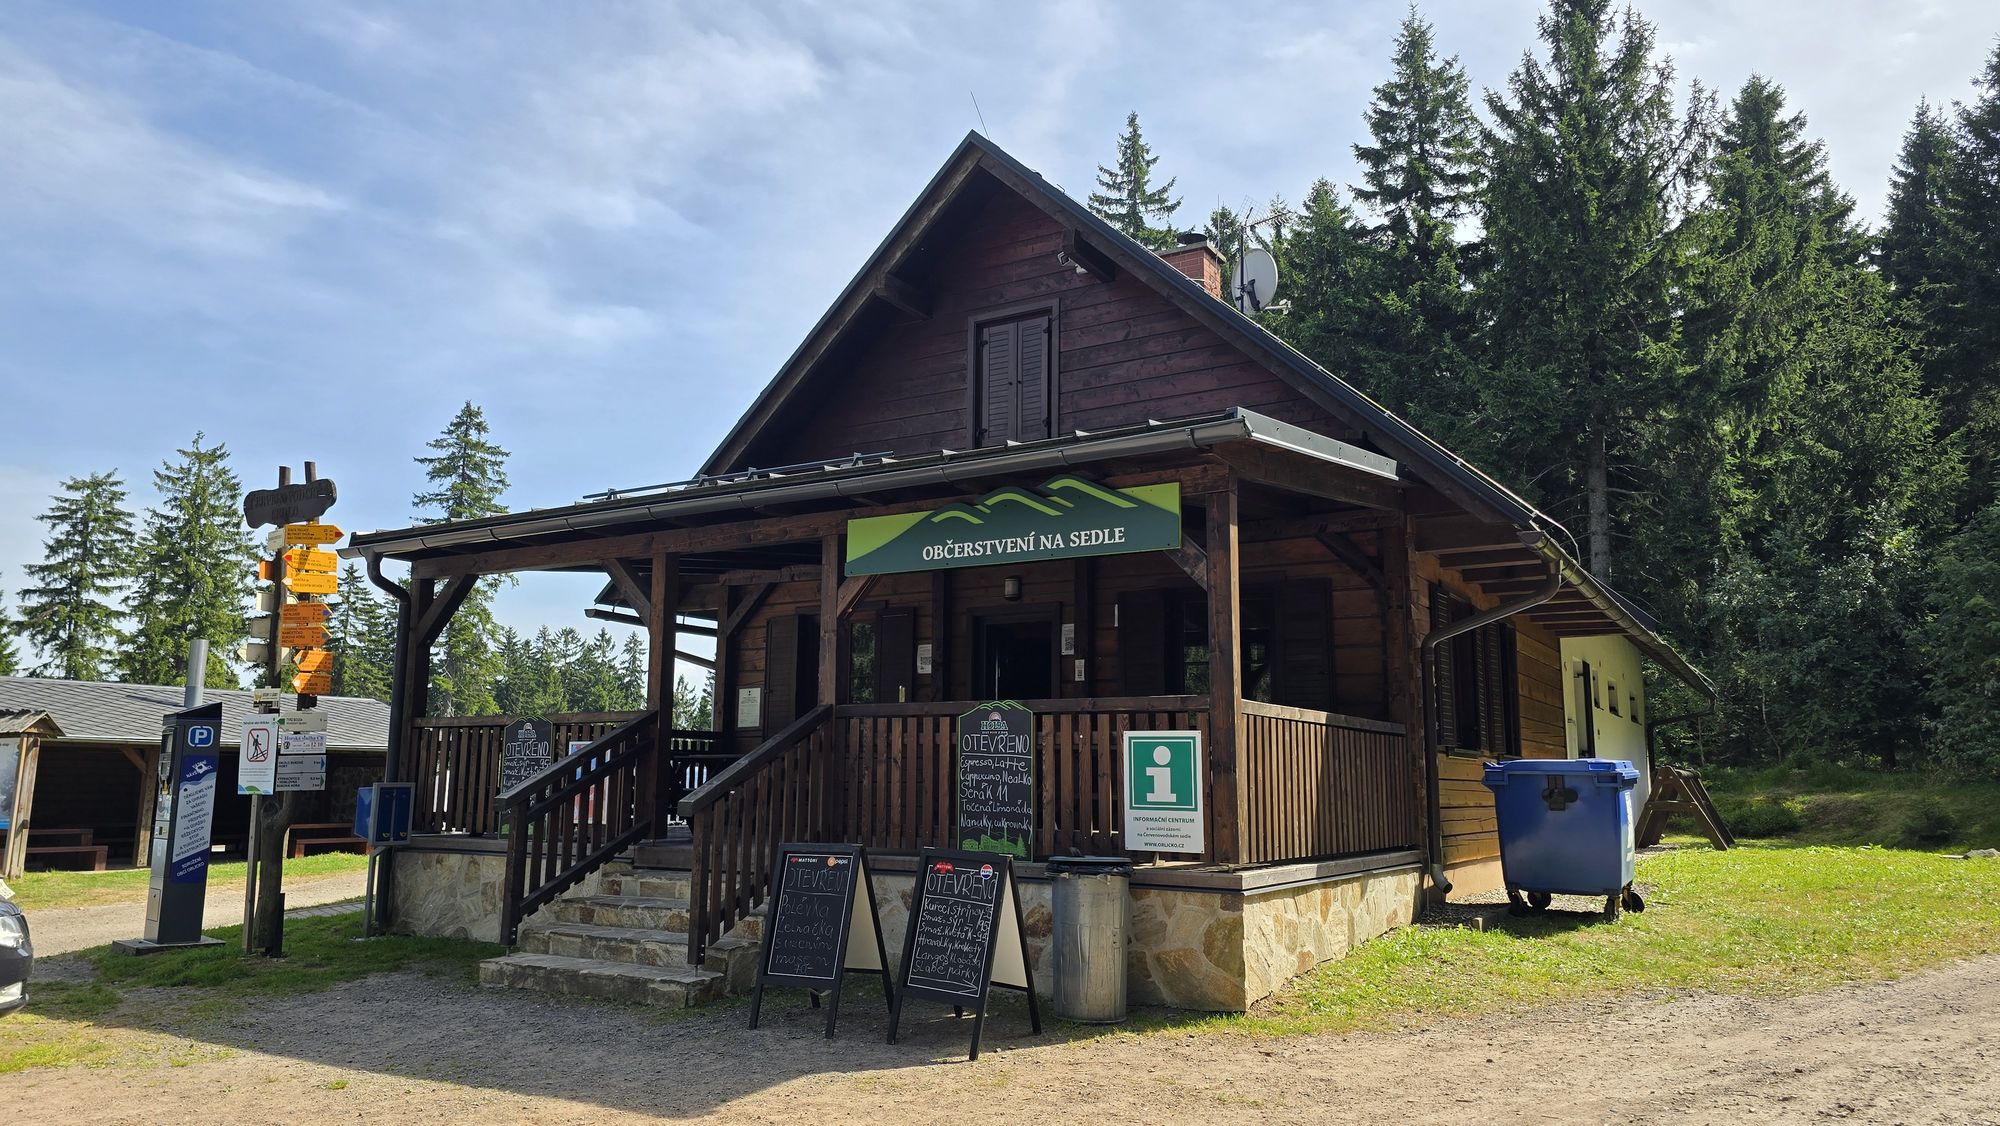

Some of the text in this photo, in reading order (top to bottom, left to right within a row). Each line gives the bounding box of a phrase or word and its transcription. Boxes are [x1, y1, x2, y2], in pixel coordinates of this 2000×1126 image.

[922, 527, 1126, 562] OBČERSTVENÍ NA SEDLE
[194, 729, 208, 744] P
[962, 733, 1030, 754] OTEVŘENO
[1132, 815, 1167, 824] INFORMAČNÍ
